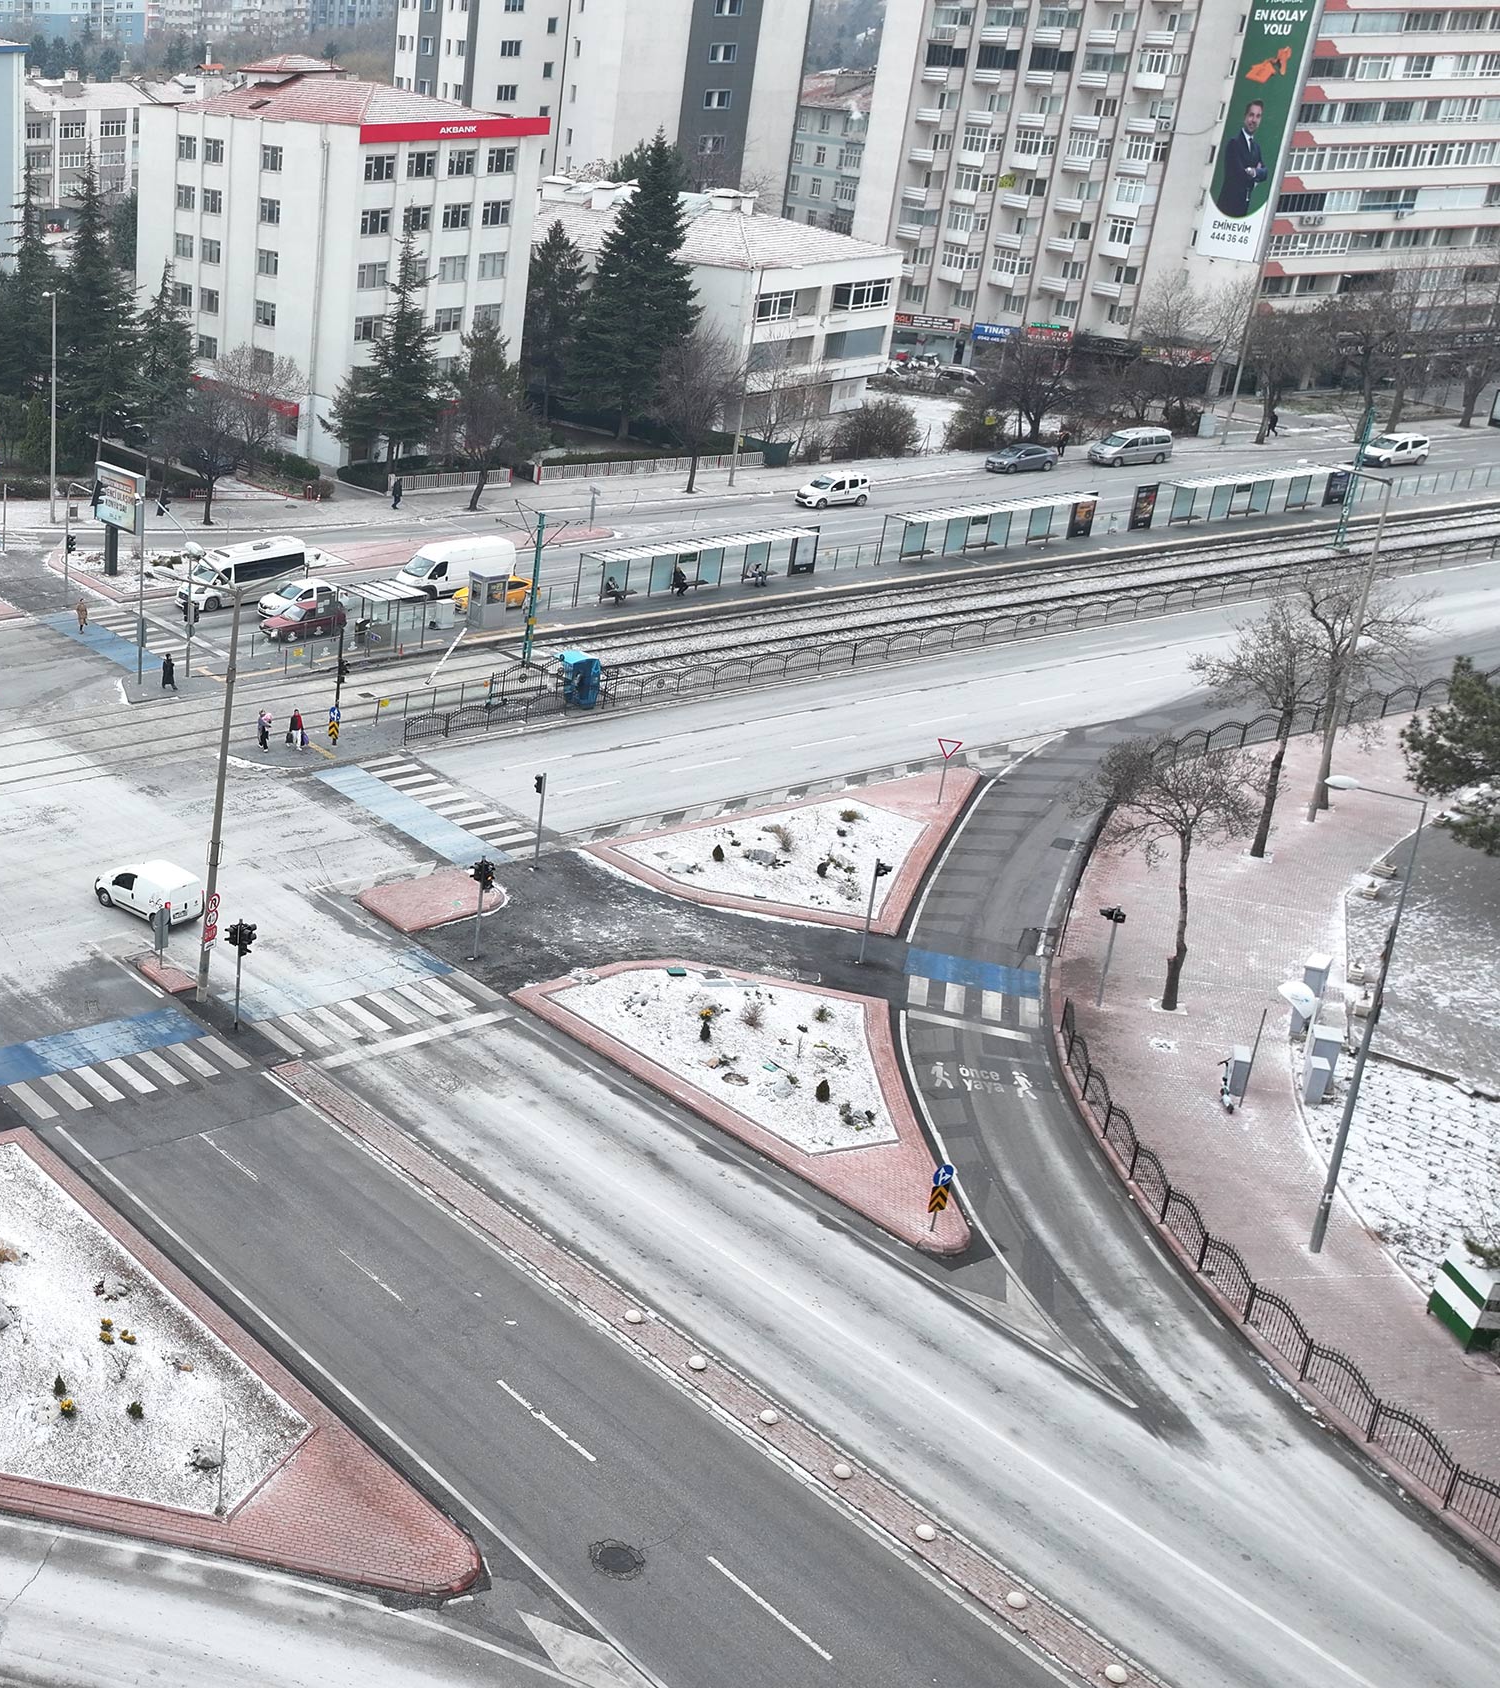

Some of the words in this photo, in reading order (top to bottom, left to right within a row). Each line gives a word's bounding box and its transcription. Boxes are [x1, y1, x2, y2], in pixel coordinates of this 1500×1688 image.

[1254, 9, 1269, 20] EN
[1269, 9, 1308, 22] KOLAY
[1263, 23, 1292, 35] YOLU
[439, 125, 477, 134] AKBANK
[1212, 219, 1251, 234] EMİNEVİM
[1210, 232, 1226, 241] 444
[1226, 233, 1237, 243] 36
[1238, 235, 1249, 245] 46
[958, 1064, 1000, 1081] önce
[962, 1078, 1005, 1095] yaya
